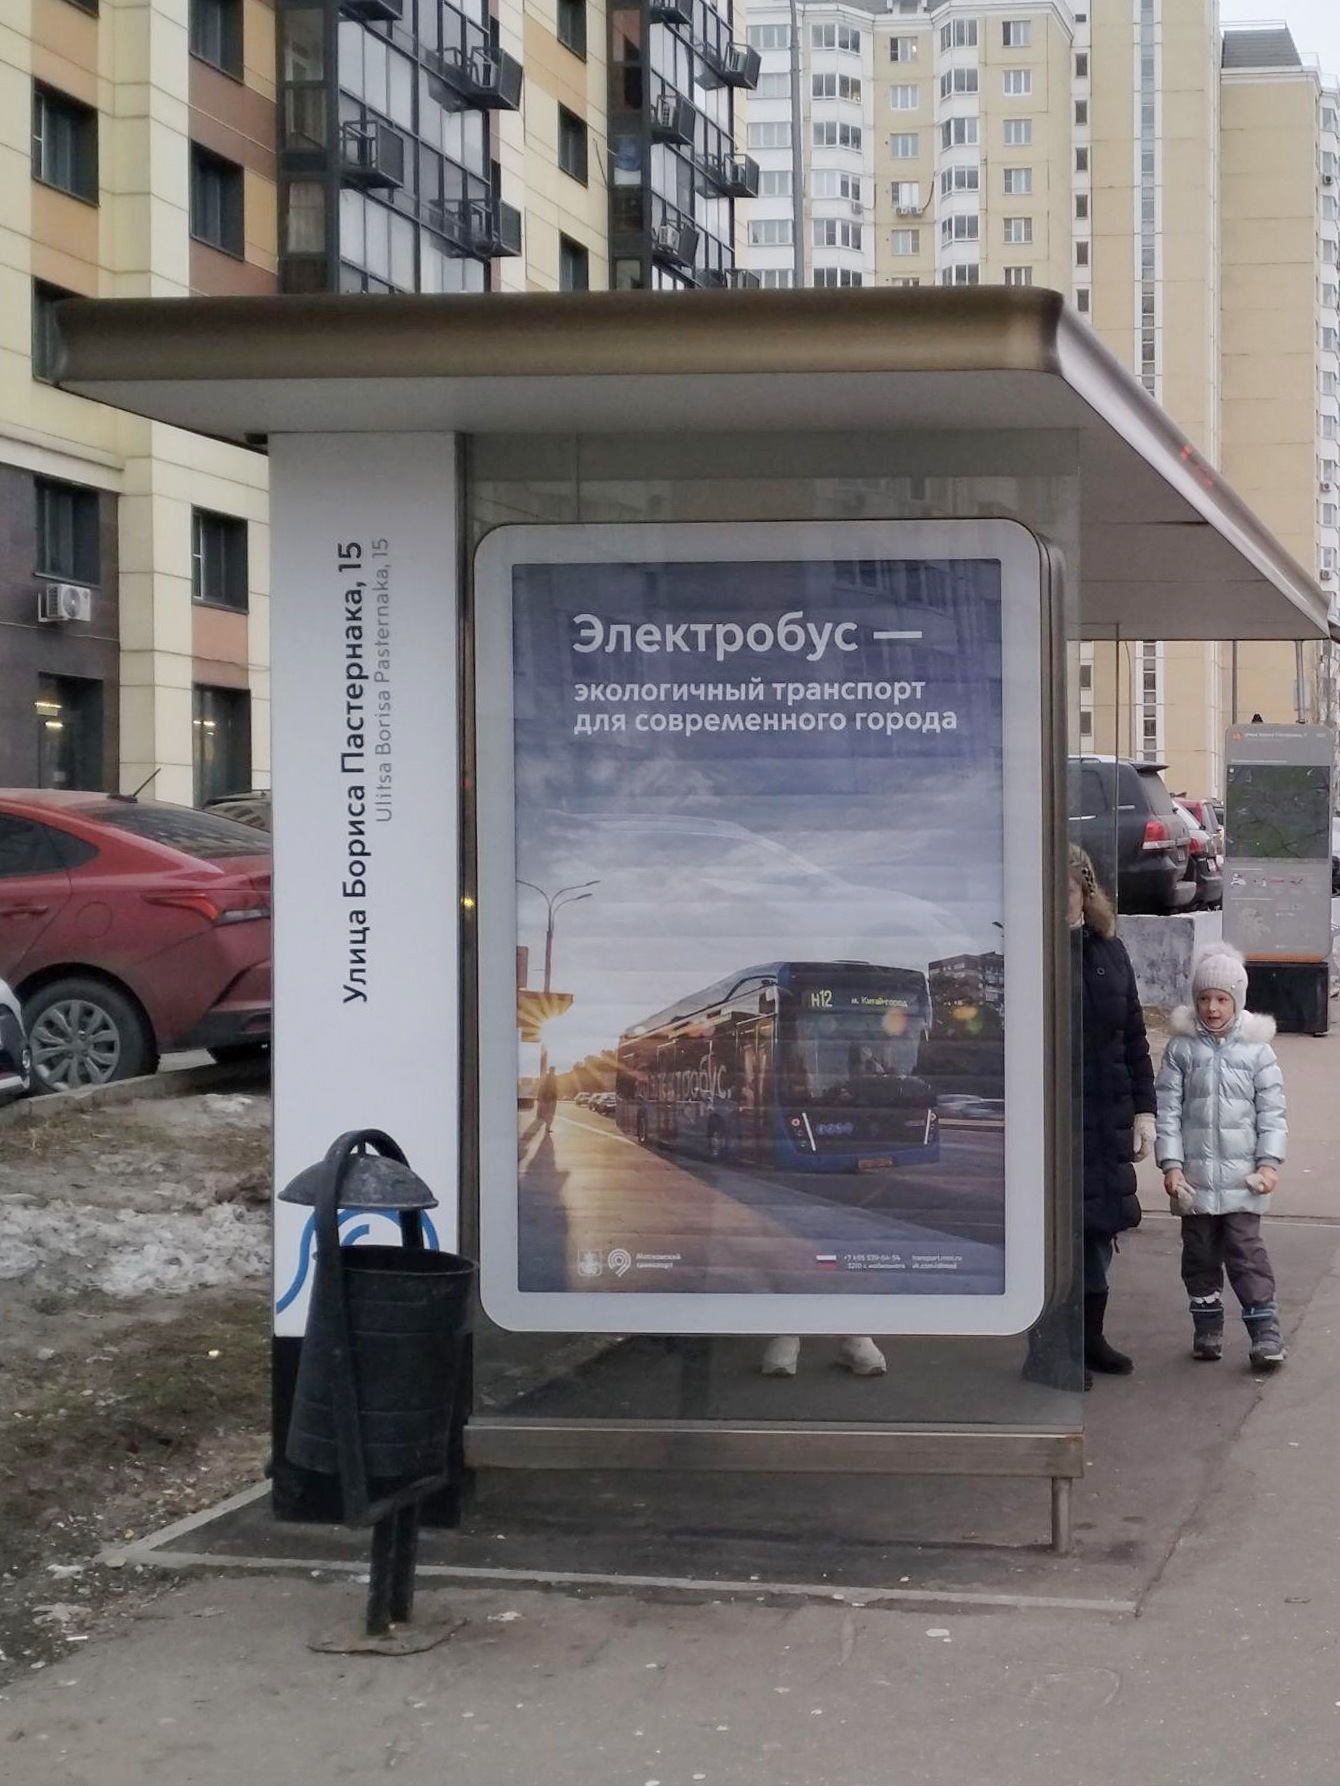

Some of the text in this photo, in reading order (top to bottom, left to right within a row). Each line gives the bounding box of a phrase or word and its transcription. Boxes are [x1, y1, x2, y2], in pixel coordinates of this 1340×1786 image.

[572, 611, 858, 661] Электробус
[372, 538, 392, 822] Ulitsa Borisa Pasternaka, 15
[574, 677, 926, 705] экологичный транспорт
[574, 709, 958, 736] для современного города
[338, 542, 371, 1003] Улица Бориса Пастернака, 15
